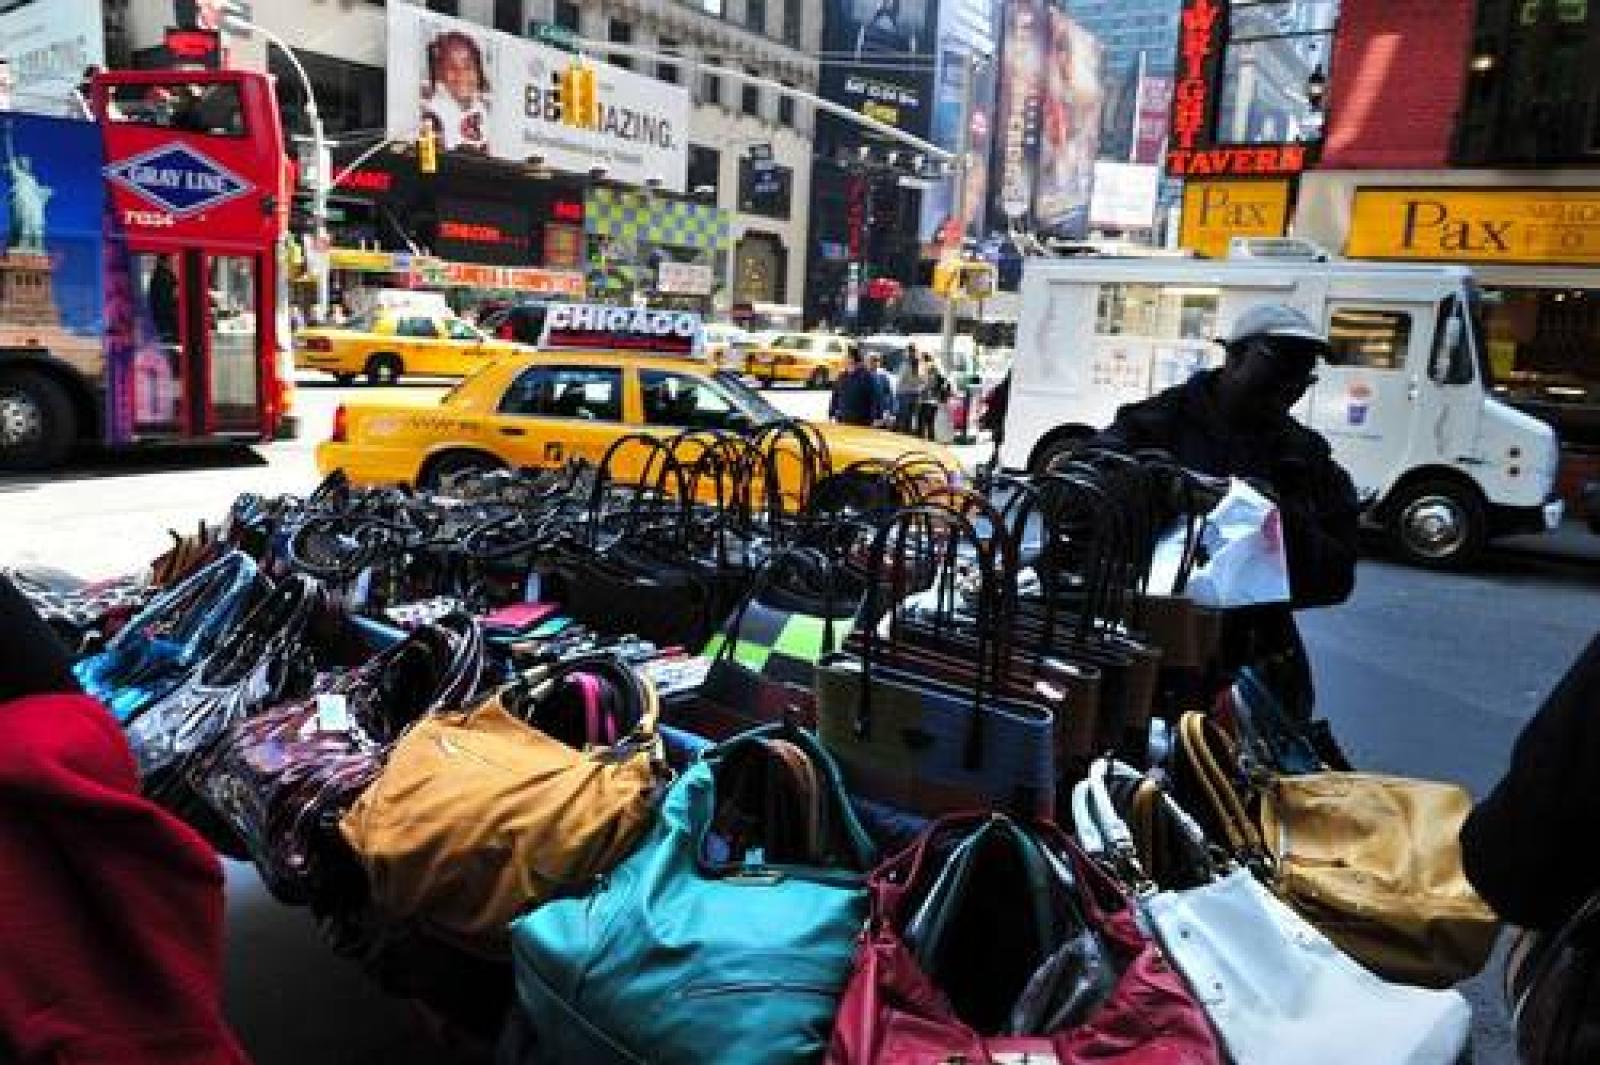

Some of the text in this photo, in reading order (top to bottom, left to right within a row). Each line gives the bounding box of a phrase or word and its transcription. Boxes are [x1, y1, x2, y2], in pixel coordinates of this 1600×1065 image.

[1168, 146, 1305, 174] TAVERN
[130, 165, 225, 194] GRAY LINE
[1199, 185, 1269, 227] Pax
[1401, 200, 1516, 251] Pax
[547, 303, 698, 337] CHICAGO
